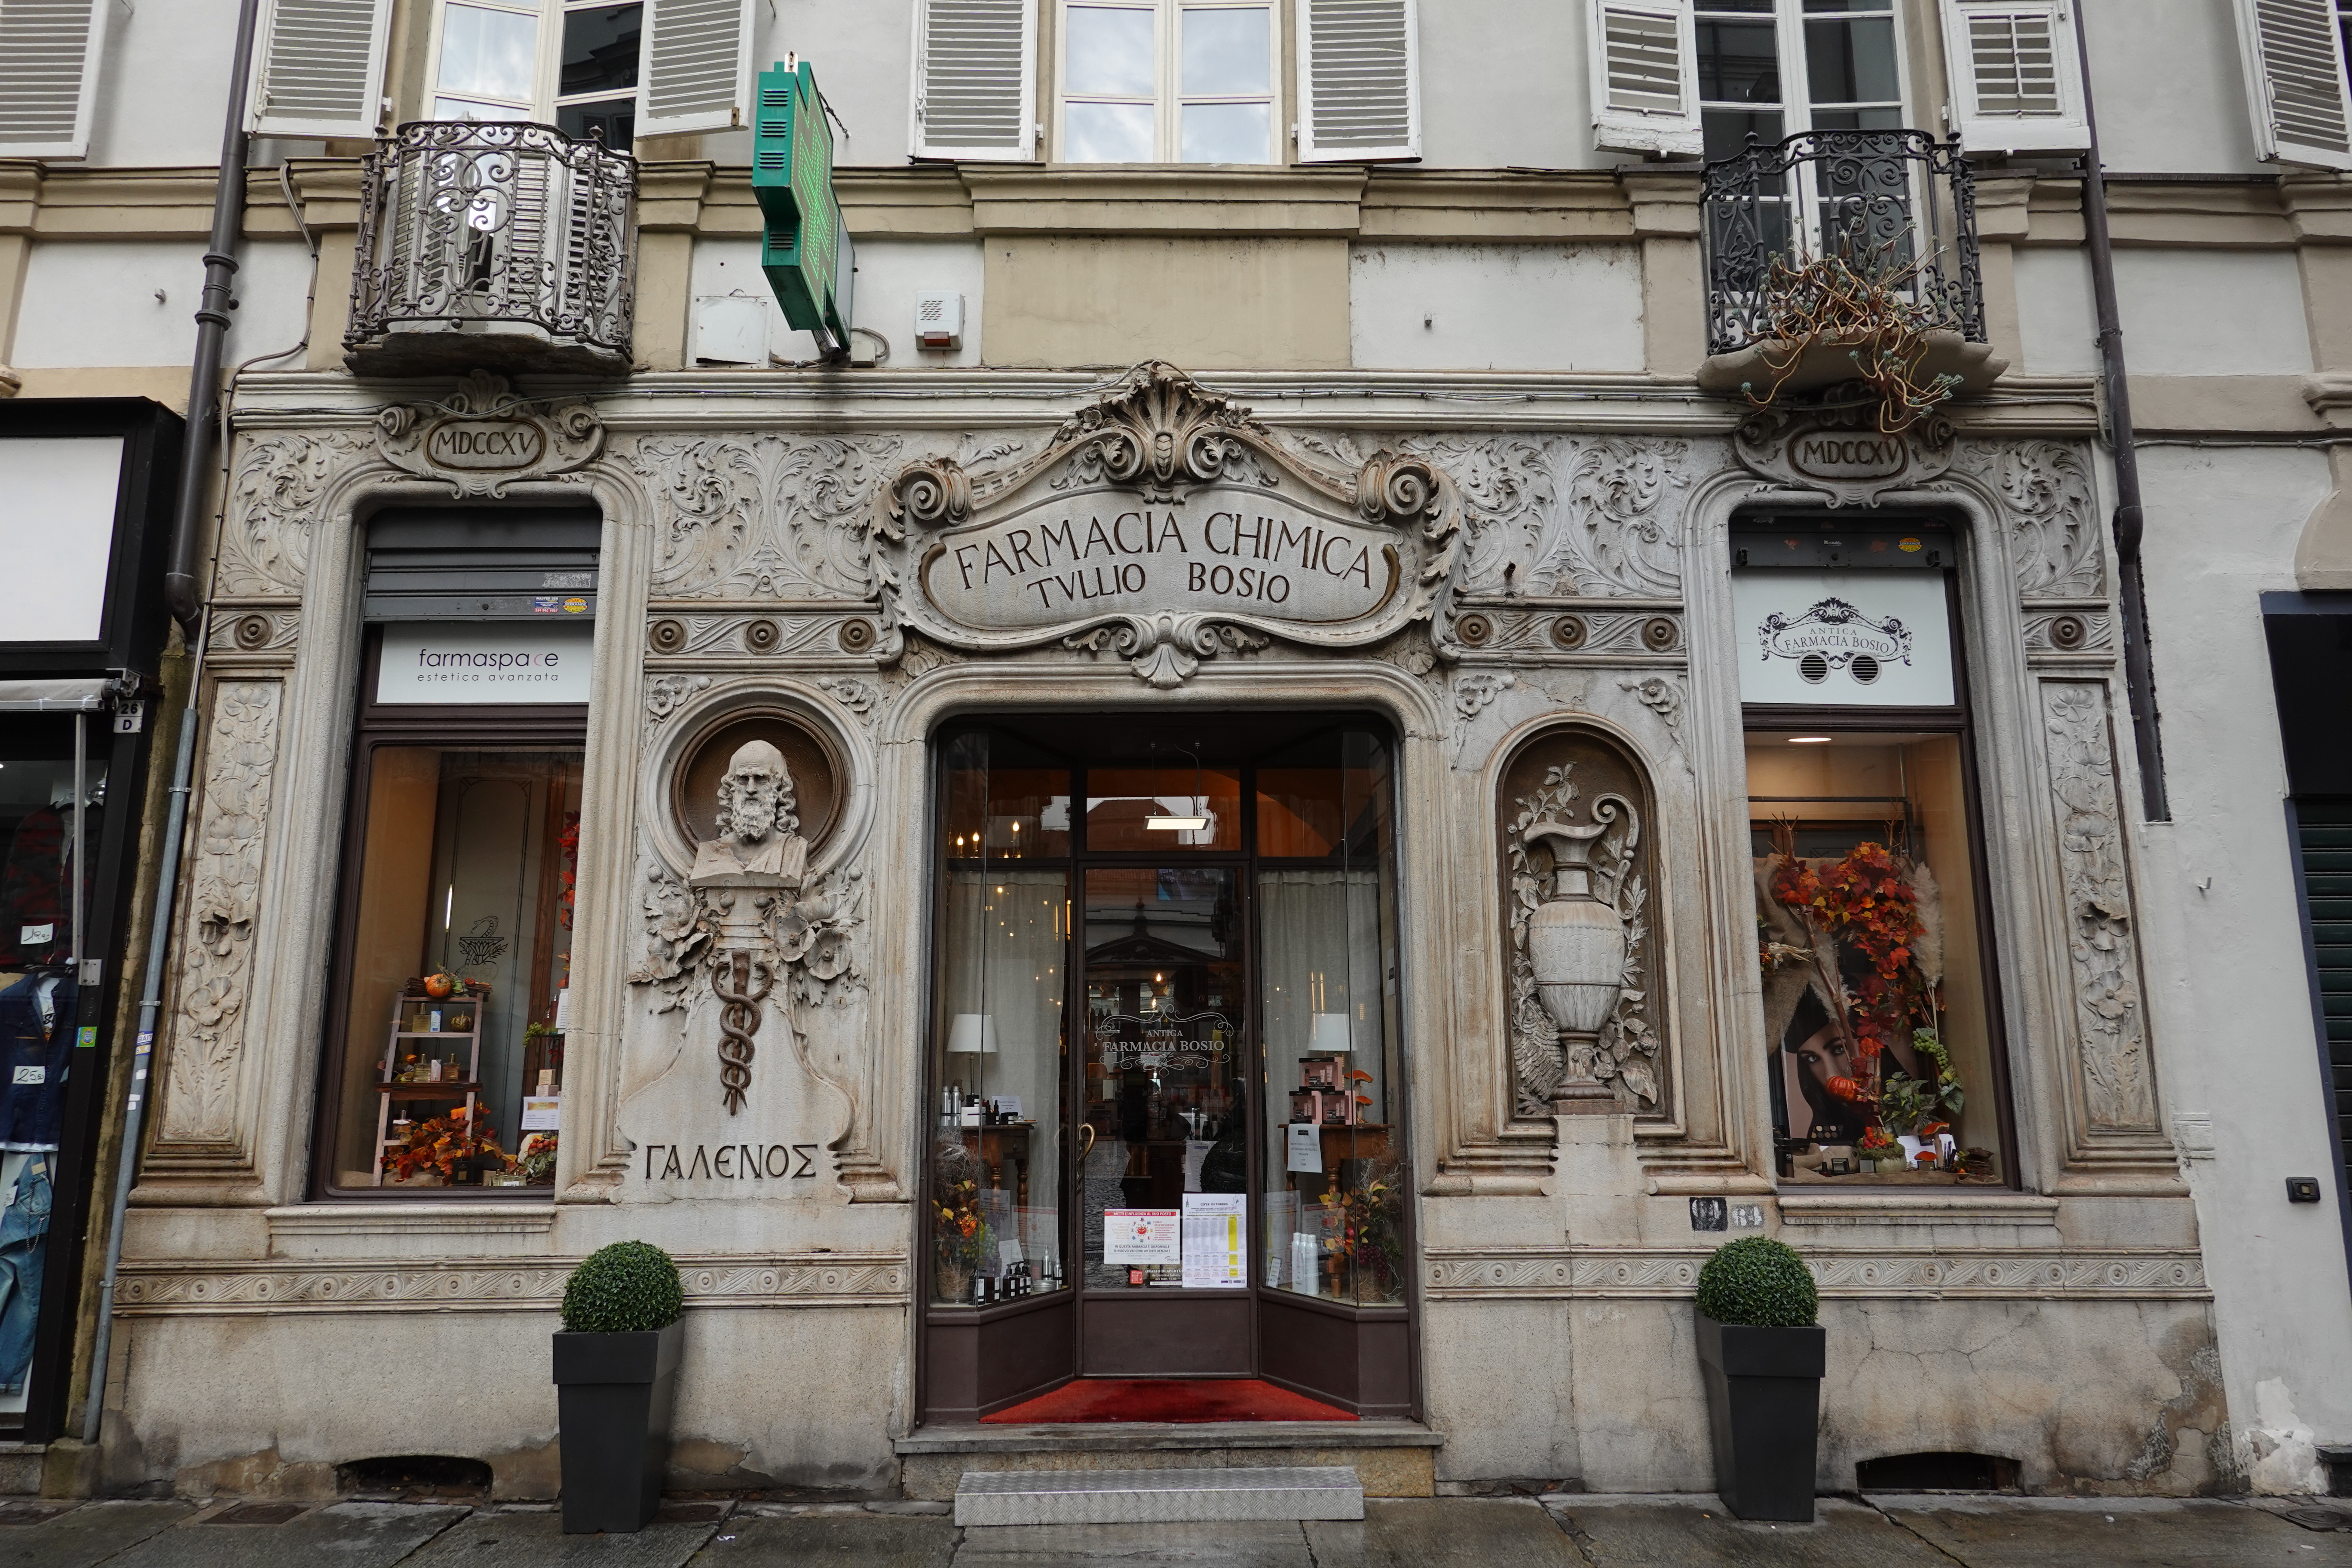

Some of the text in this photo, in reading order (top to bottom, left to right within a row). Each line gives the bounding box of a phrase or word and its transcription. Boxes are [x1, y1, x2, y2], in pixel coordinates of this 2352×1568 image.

[435, 431, 536, 455] MDCCXV
[1803, 440, 1900, 465] MDCCXV
[955, 511, 1370, 589] FARMACIA CHIMICA
[1027, 561, 1290, 608] TVLLIO BOSIO
[1810, 627, 1857, 635] ANTICA
[1784, 635, 1889, 653] FARMACIA BOSIO
[420, 649, 558, 671] farmaspace
[418, 672, 558, 681] estetica avanzata
[121, 703, 138, 714] 26
[122, 719, 132, 730] D
[1103, 1041, 1225, 1052] FARMACIA BOSIO
